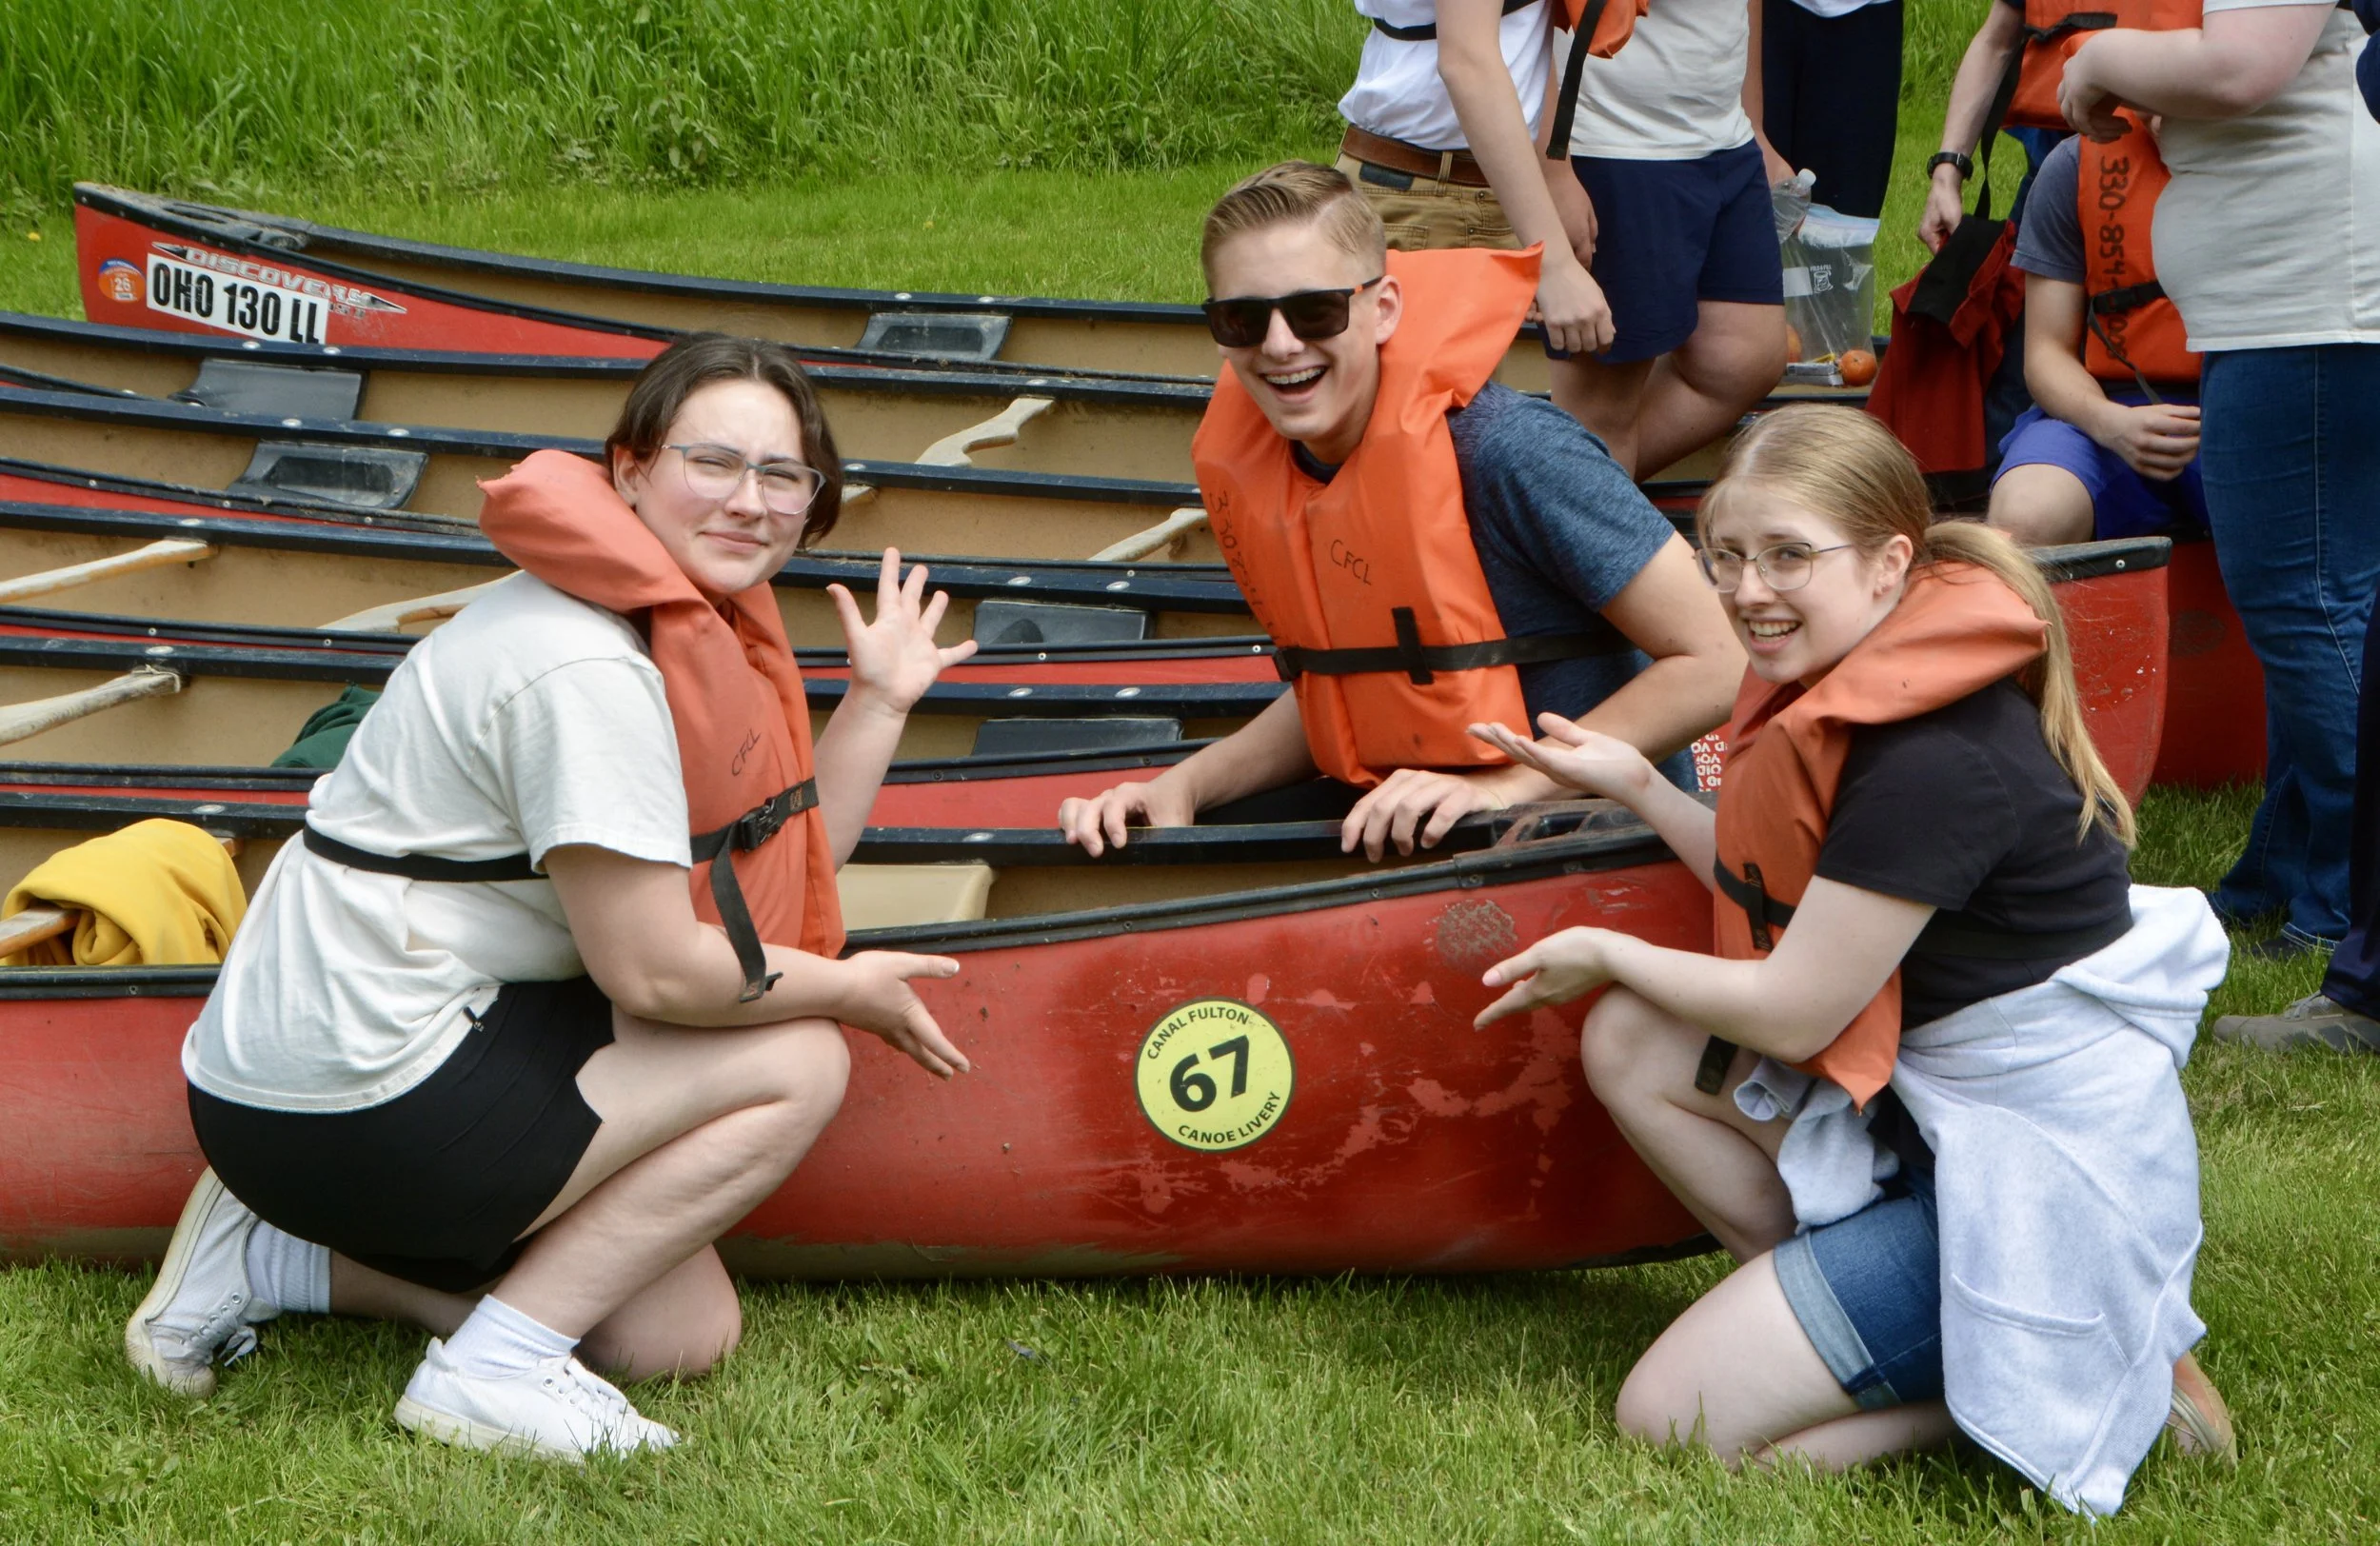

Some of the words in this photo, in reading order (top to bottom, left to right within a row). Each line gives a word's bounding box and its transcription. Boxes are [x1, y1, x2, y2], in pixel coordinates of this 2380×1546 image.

[186, 247, 370, 306] DISCOVERY
[223, 282, 282, 336] 130
[289, 298, 319, 344] LL
[1330, 539, 1372, 585] CFCL
[1147, 1017, 1187, 1060] CANAL
[1187, 1006, 1249, 1025] FULTON
[1169, 1034, 1250, 1113] 67
[1178, 1124, 1237, 1144] CANOE
[1238, 1091, 1281, 1139] LIVERY
